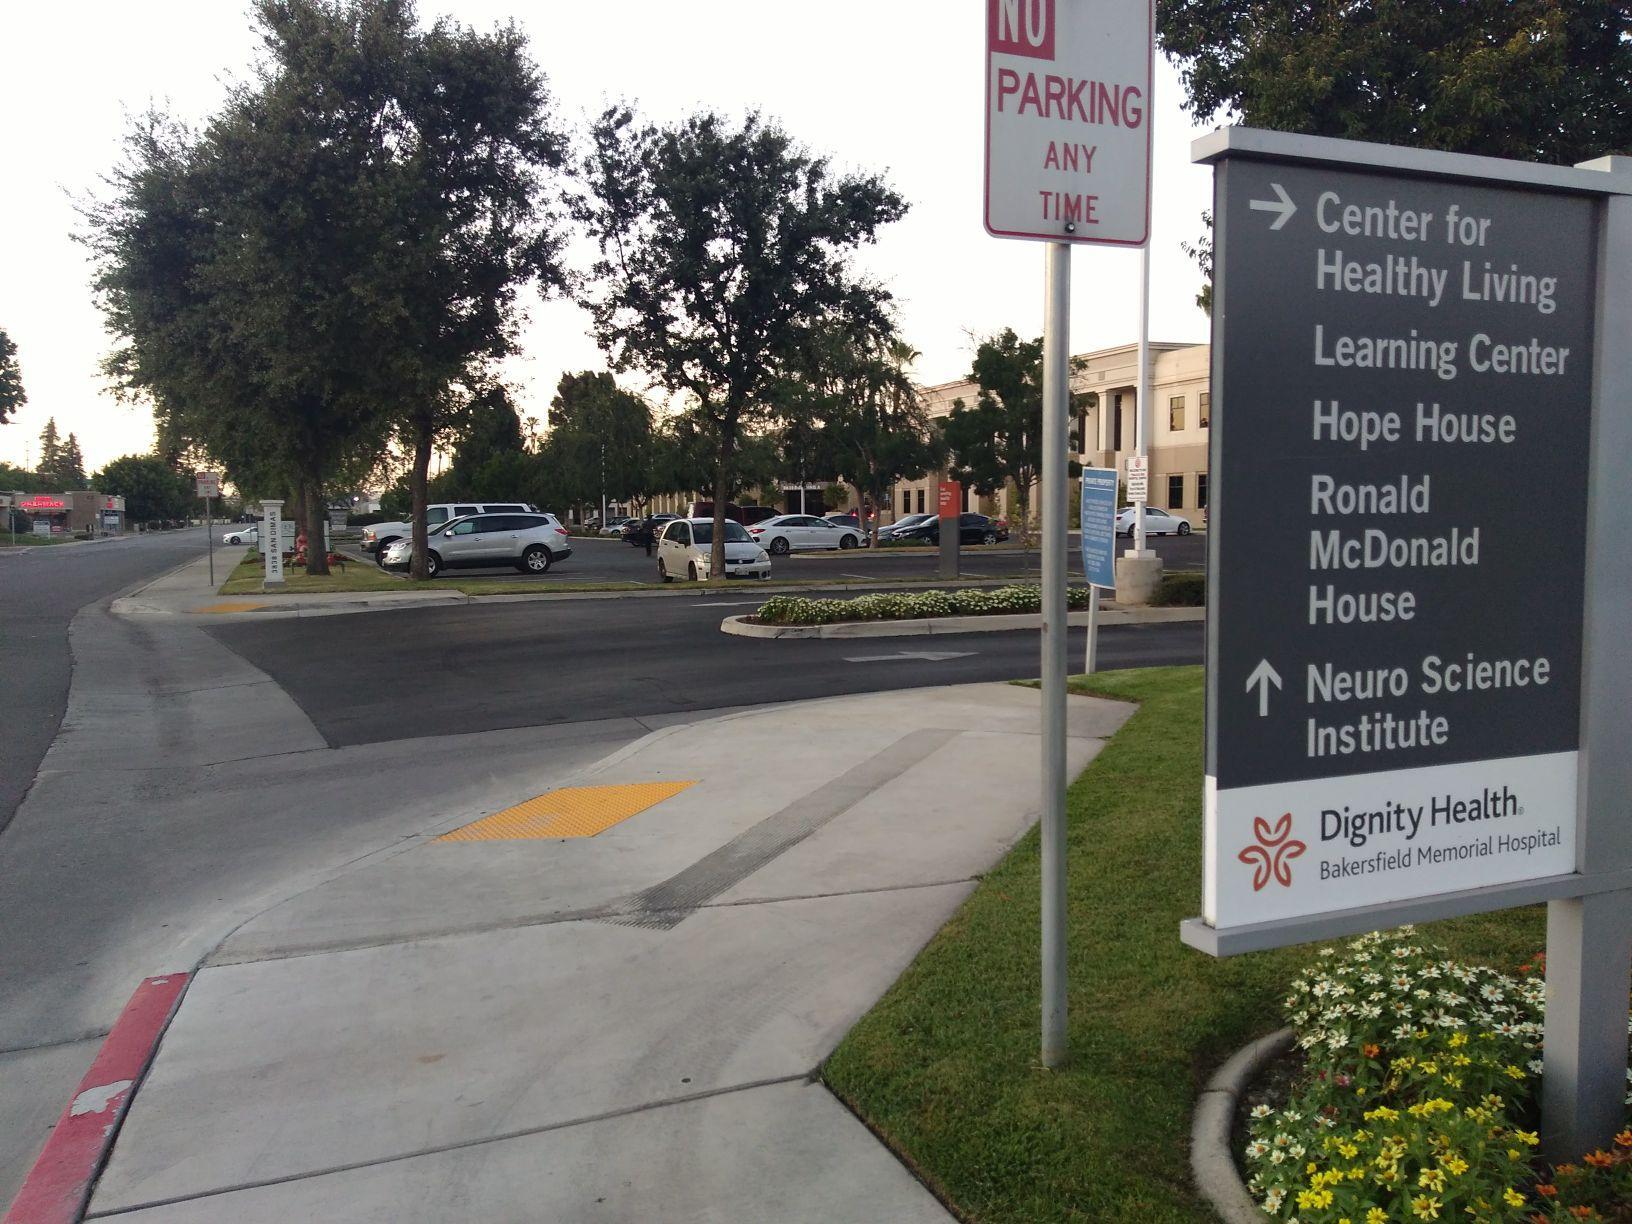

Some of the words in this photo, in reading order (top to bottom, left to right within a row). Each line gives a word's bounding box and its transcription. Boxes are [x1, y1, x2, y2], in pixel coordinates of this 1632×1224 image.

[998, 0, 1046, 48] NO
[997, 67, 1142, 129] PARKING
[1043, 141, 1097, 174] ANY
[1039, 191, 1100, 225] TIME
[1316, 191, 1433, 242] Center
[1446, 204, 1492, 247] for
[1316, 249, 1448, 307] Healthy
[1462, 260, 1557, 315] Living
[1314, 324, 1458, 380] Learning
[1468, 333, 1570, 376] Center
[1313, 400, 1401, 451] Hope
[1416, 403, 1517, 444] House
[1310, 474, 1430, 515] Ronald
[269, 511, 277, 536] DIMAS
[1309, 527, 1480, 570] McDonald
[1308, 584, 1416, 625] House
[1307, 663, 1409, 704] Neuro
[1421, 652, 1551, 695] Science
[1307, 710, 1449, 758] Institute
[1320, 801, 1424, 848] Dignity
[1320, 847, 1412, 881] Bakersfield
[1417, 838, 1493, 866] Memorial
[1497, 826, 1561, 856] Hospital
